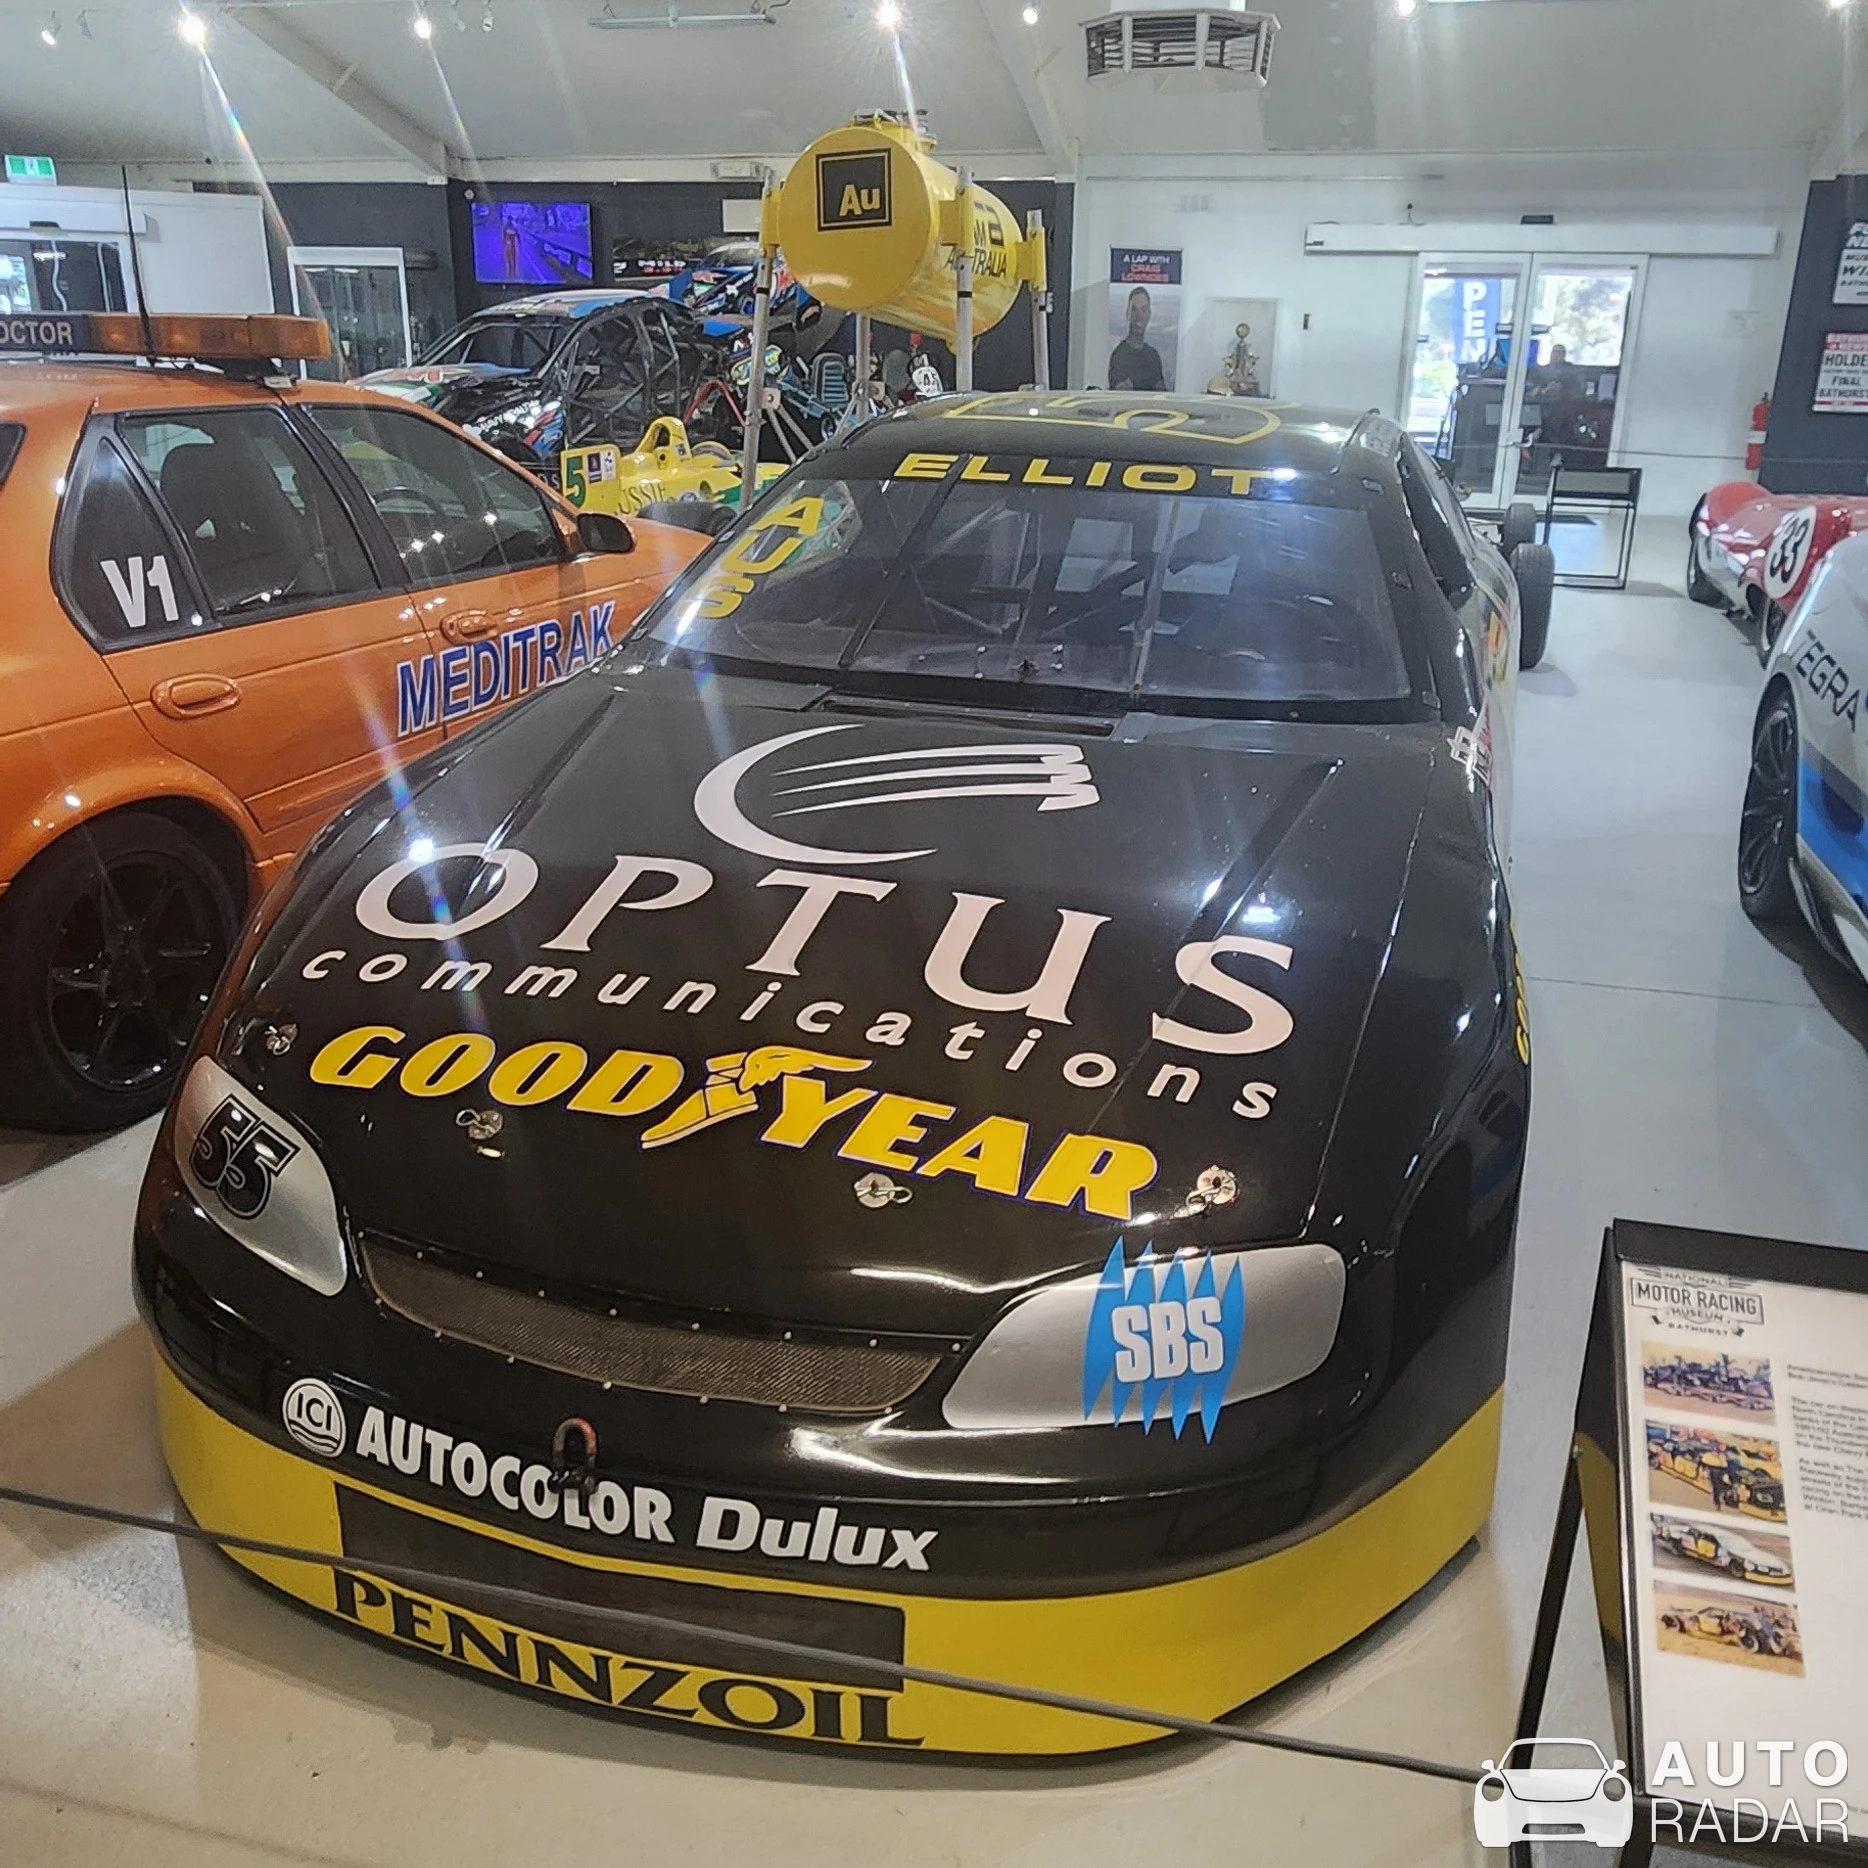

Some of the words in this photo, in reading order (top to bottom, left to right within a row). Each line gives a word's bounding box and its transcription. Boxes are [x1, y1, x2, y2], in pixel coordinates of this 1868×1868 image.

[839, 184, 881, 216] Au
[1122, 254, 1130, 263] A
[1132, 255, 1148, 263] LAP
[1149, 256, 1170, 264] WITH
[565, 455, 587, 508] 5
[893, 452, 1275, 496] ELLIOT
[1769, 517, 1811, 584] 33
[101, 555, 180, 628] V1
[396, 600, 619, 738] MEDITRAK
[355, 842, 1295, 1055] OPTUS
[301, 949, 1279, 1120] communications
[188, 1093, 301, 1219] 55
[1637, 1282, 1692, 1306] MOTOR
[1697, 1289, 1757, 1315] RACING
[1664, 1271, 1724, 1286] NATIONAL
[1111, 1296, 1224, 1383] SBS
[1671, 1307, 1724, 1322] MUSEUM
[297, 1392, 333, 1432] ICI
[355, 1405, 675, 1544] AUTOCOLOR
[695, 1496, 939, 1571] Dulux
[333, 1566, 926, 1747] PENNZOIL
